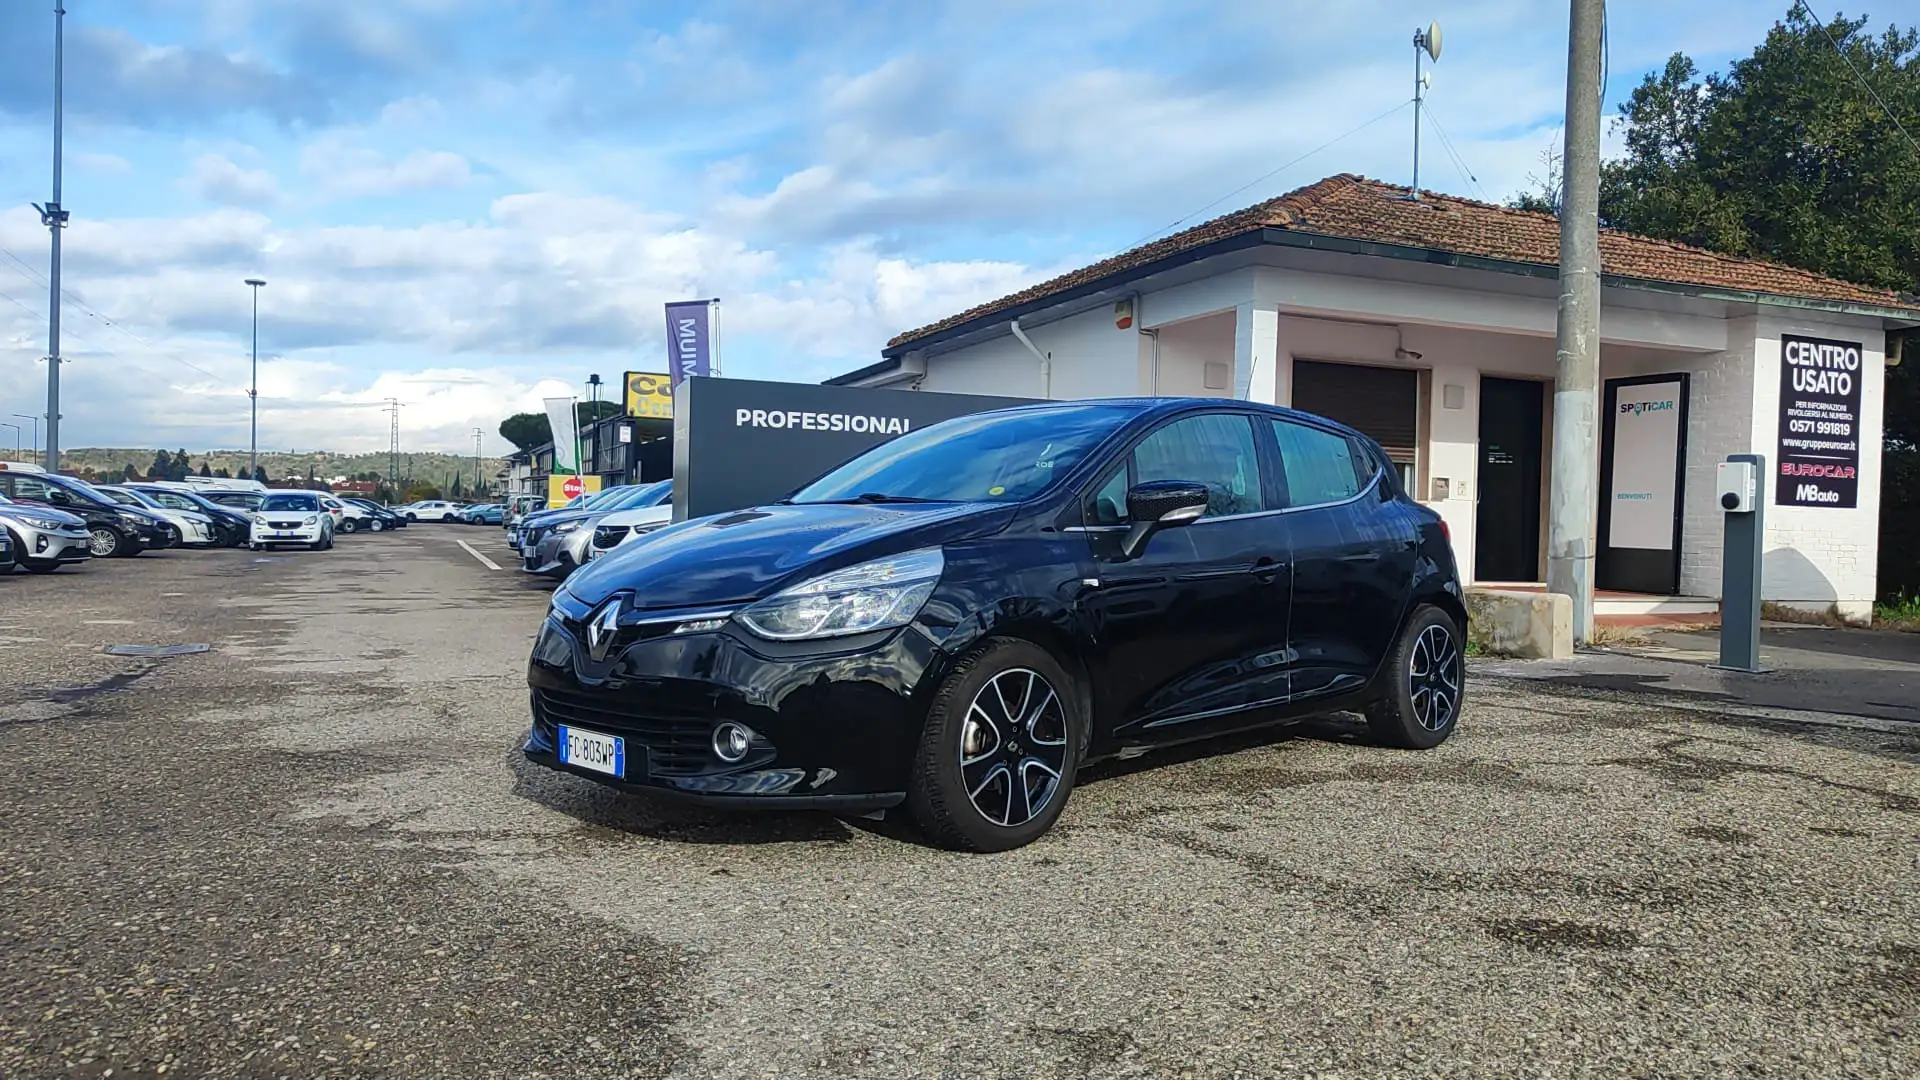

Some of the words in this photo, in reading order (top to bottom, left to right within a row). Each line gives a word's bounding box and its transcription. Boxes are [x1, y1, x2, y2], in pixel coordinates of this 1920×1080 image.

[1786, 341, 1859, 371] CENTRO
[1793, 368, 1852, 396] USATO
[1787, 408, 1820, 418] RIVOLGERSI
[1795, 400, 1807, 408] PER
[1808, 401, 1847, 412] INFORMAZIONI
[1789, 419, 1815, 433] 0571
[1816, 421, 1851, 436] 991819
[1782, 438, 1856, 451] www.gruppoeurocar.it
[1781, 462, 1856, 479] EUROCAR
